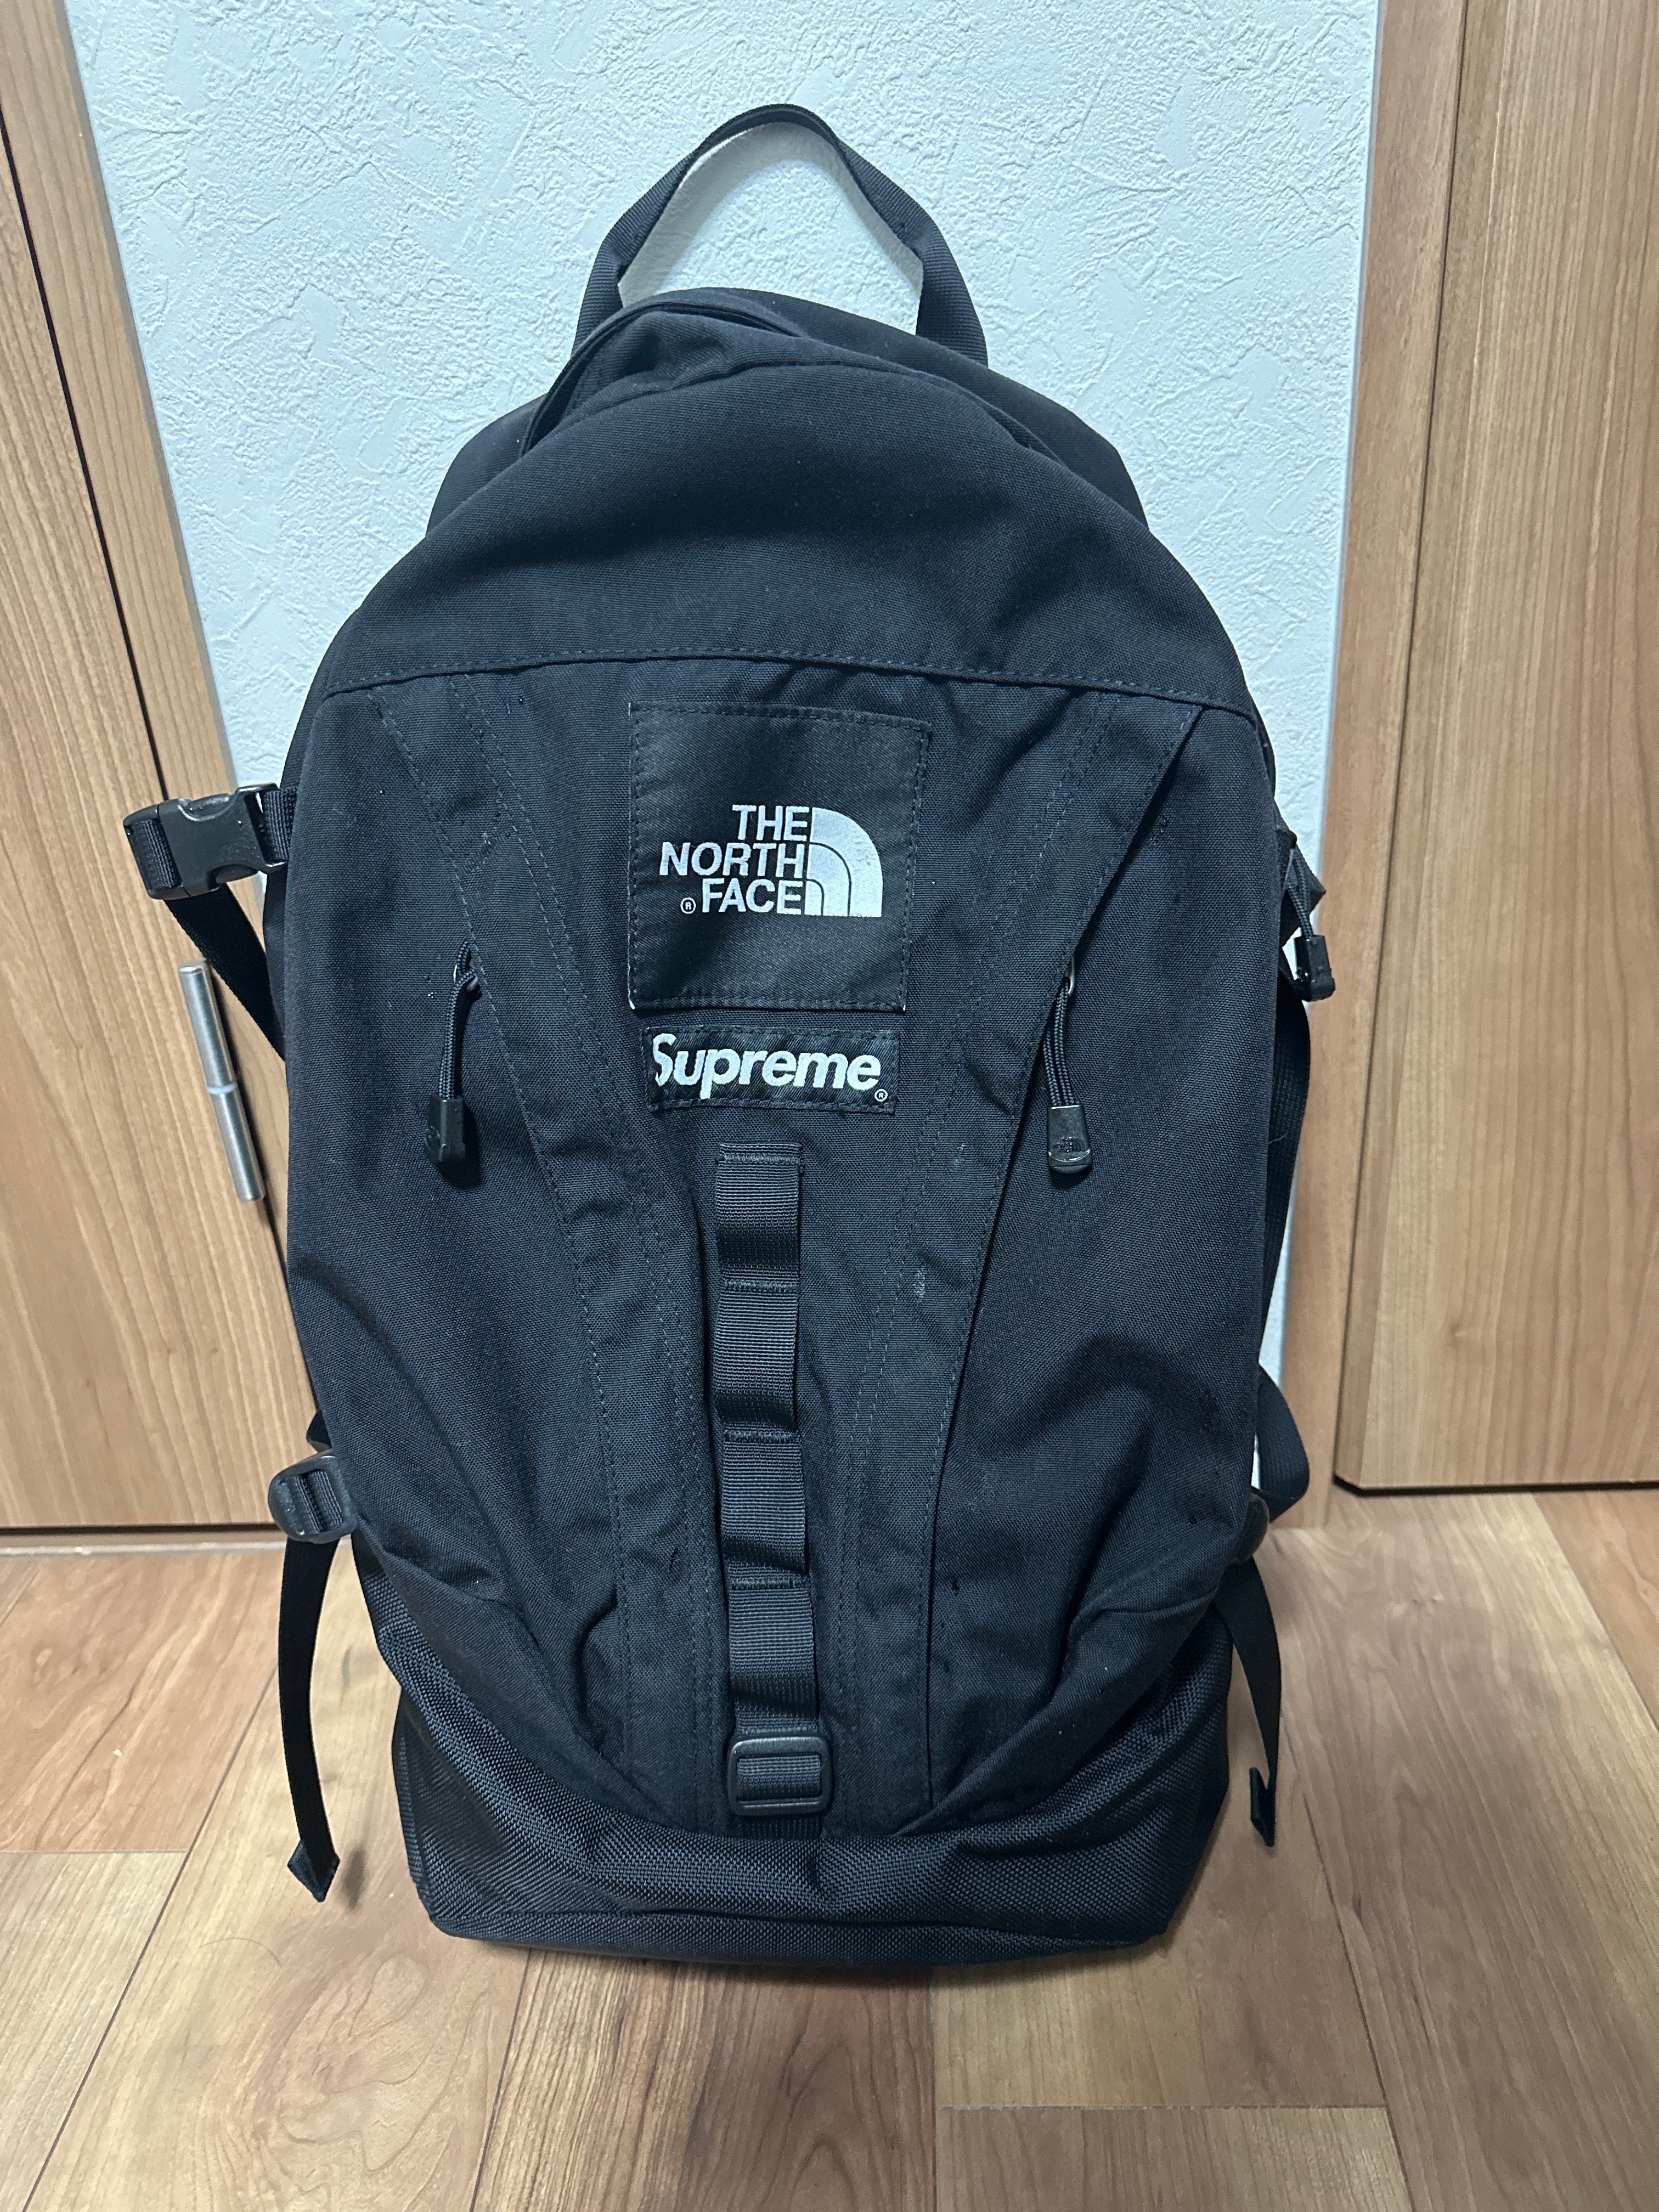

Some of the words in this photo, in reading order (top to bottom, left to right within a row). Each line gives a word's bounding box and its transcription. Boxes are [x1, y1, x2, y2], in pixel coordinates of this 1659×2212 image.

[732, 804, 810, 842] THE
[659, 842, 805, 879] NORTH
[702, 878, 803, 915] FACE
[652, 1033, 881, 1100] Supreme
